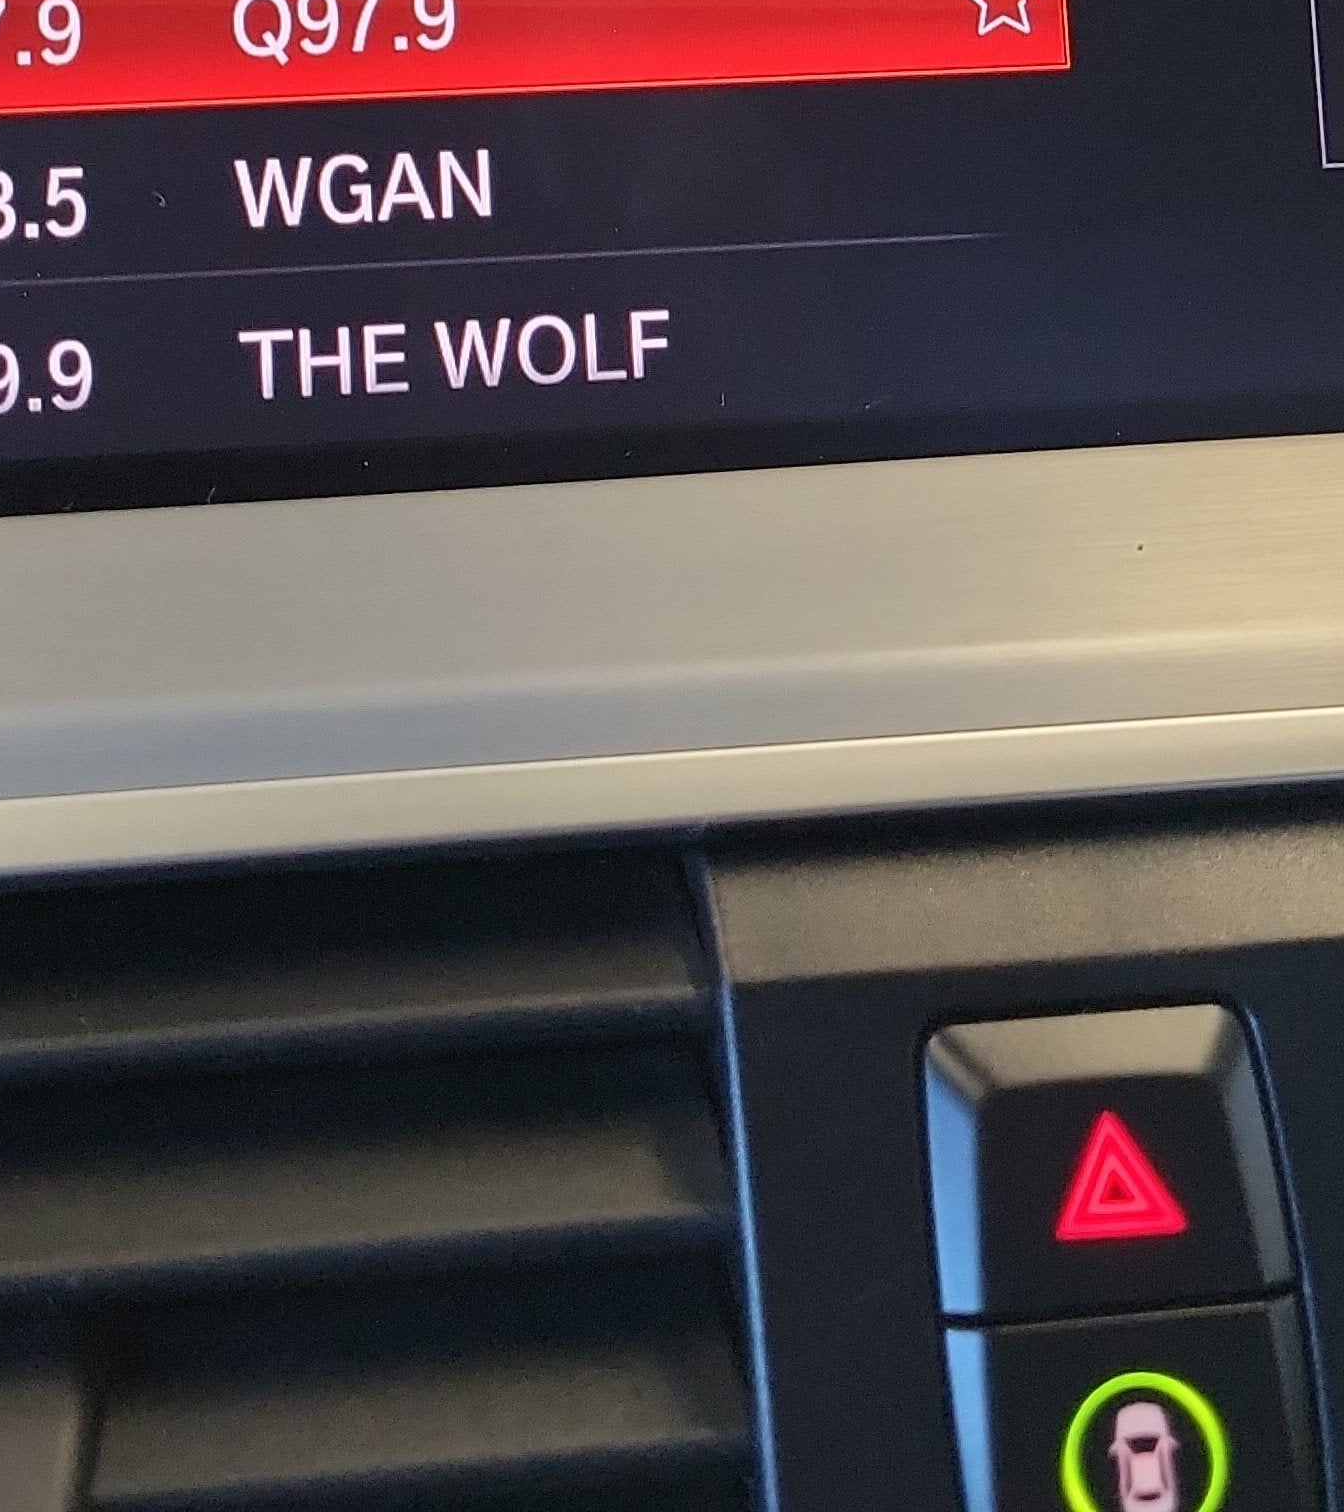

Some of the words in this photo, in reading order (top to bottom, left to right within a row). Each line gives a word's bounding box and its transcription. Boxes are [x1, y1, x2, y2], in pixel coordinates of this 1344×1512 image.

[232, 147, 493, 229] WGAN
[237, 322, 411, 401] THE
[432, 308, 671, 390] WOLF
